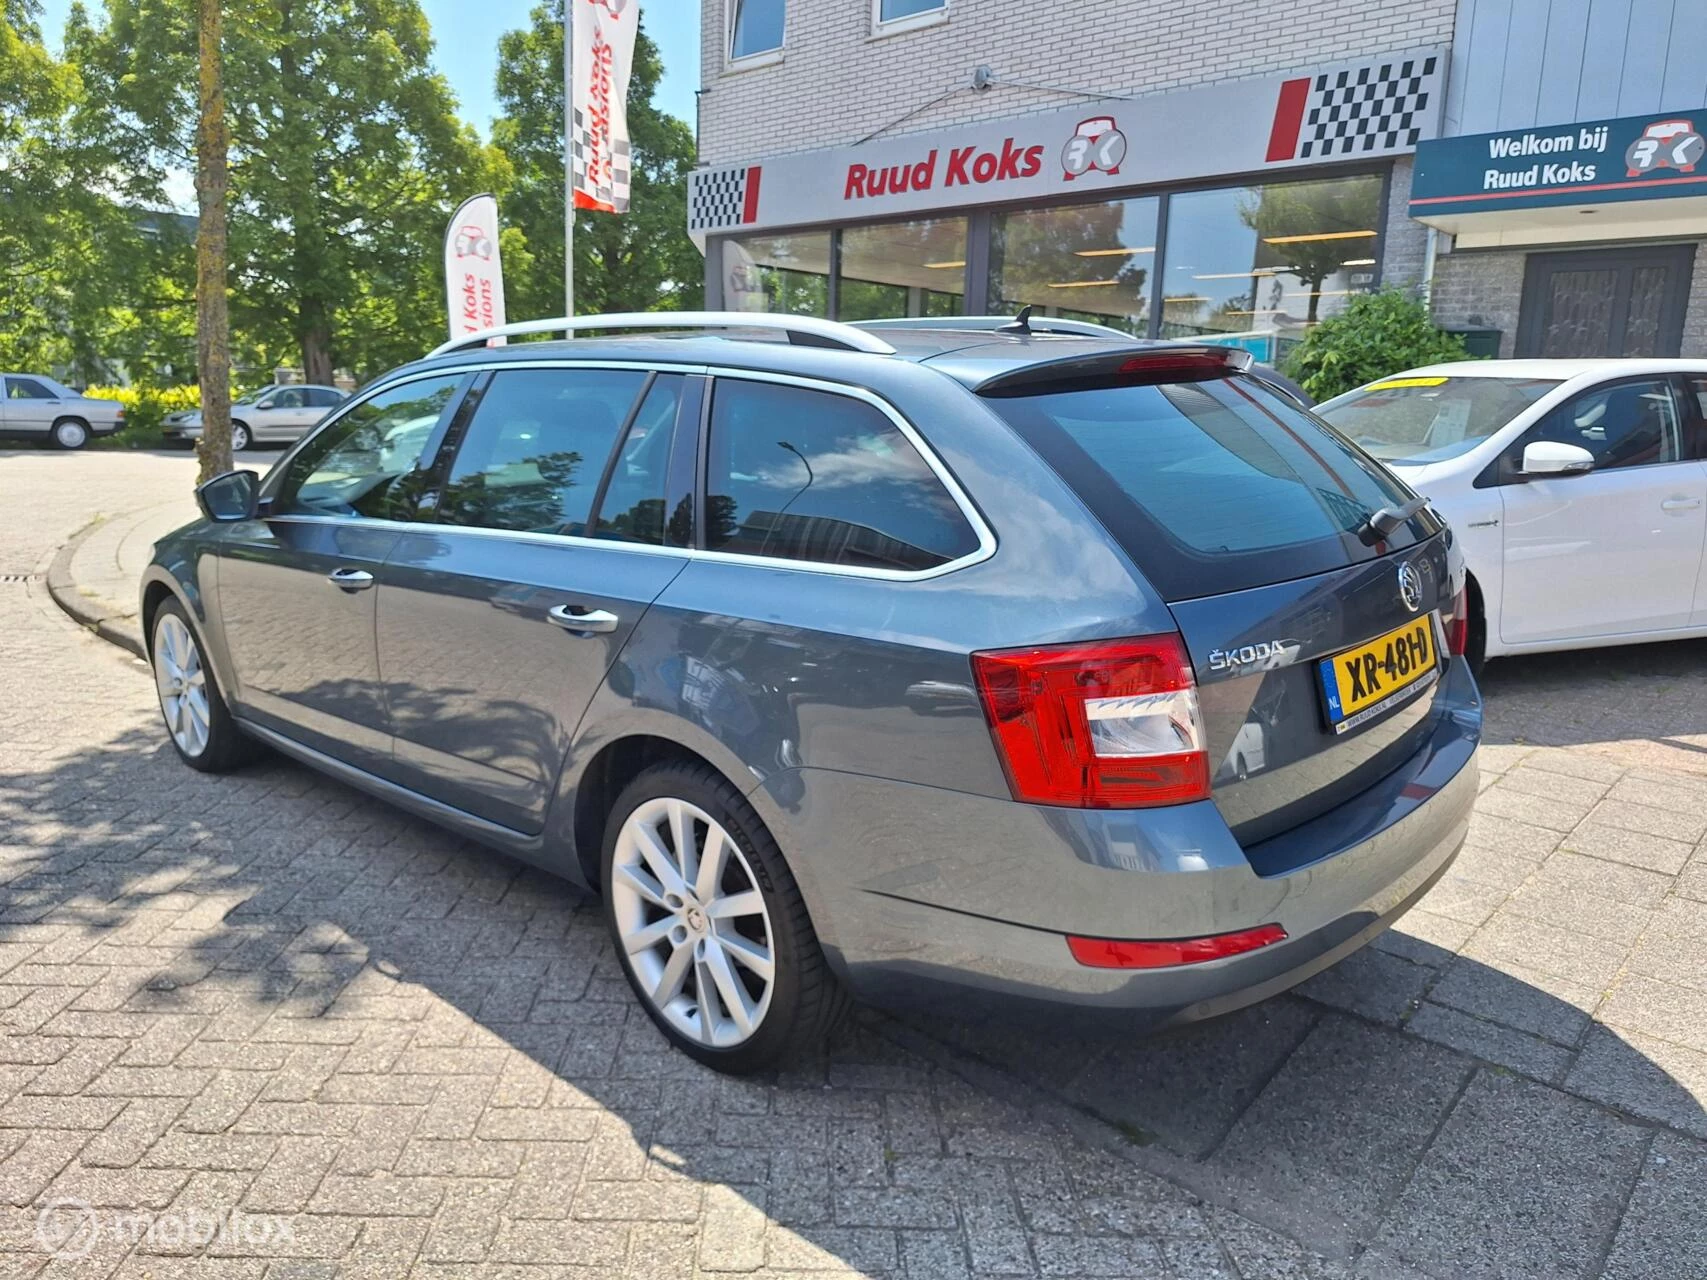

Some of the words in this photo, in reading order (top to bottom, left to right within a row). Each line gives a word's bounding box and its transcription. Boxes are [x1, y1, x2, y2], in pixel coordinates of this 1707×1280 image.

[1489, 134, 1574, 159] Welkom
[1579, 126, 1609, 153] bij
[844, 149, 938, 200] Ruud
[944, 137, 1044, 187] Koks
[1484, 164, 1539, 189] Ruud
[1542, 161, 1596, 185] Koks
[463, 273, 477, 319] Koks
[1208, 639, 1286, 670] ŠKODA
[1329, 696, 1341, 710] NL
